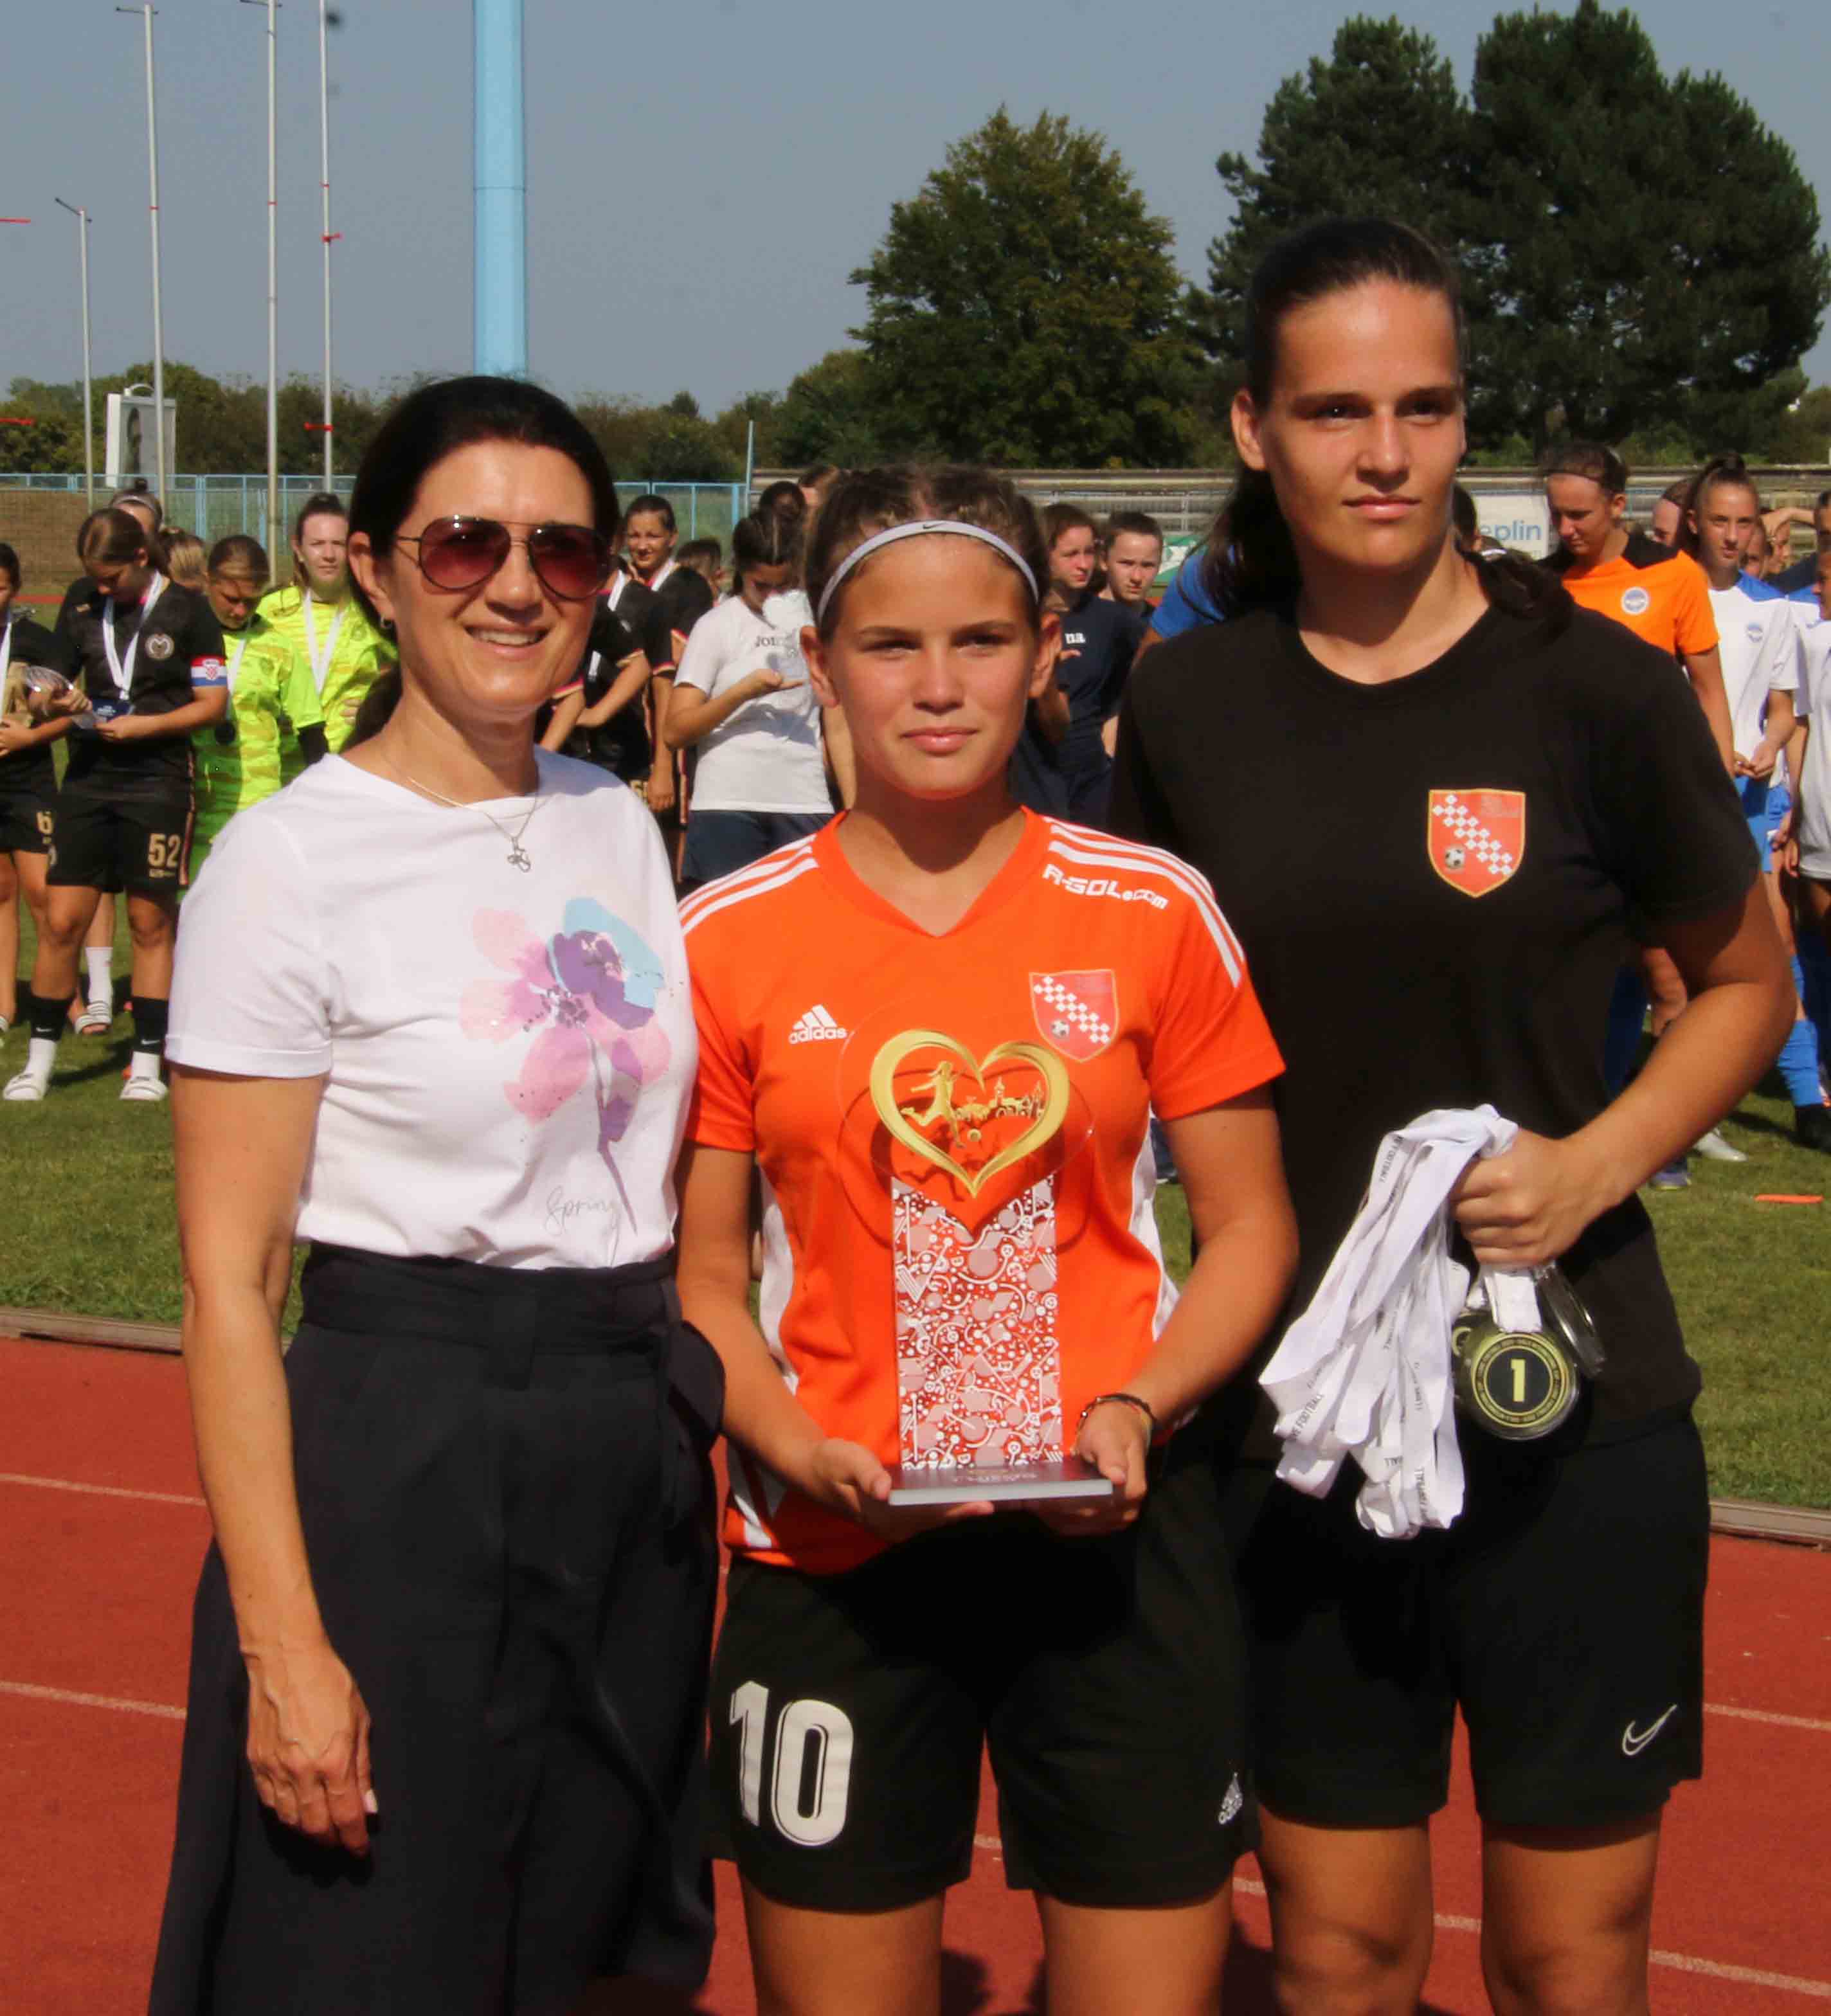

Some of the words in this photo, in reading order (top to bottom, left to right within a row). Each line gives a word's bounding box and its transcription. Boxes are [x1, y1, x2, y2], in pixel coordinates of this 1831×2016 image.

[148, 833, 181, 868] 52
[788, 1026, 848, 1045] adidas
[1511, 1358, 1526, 1403] 1
[730, 1680, 854, 1846] 10
